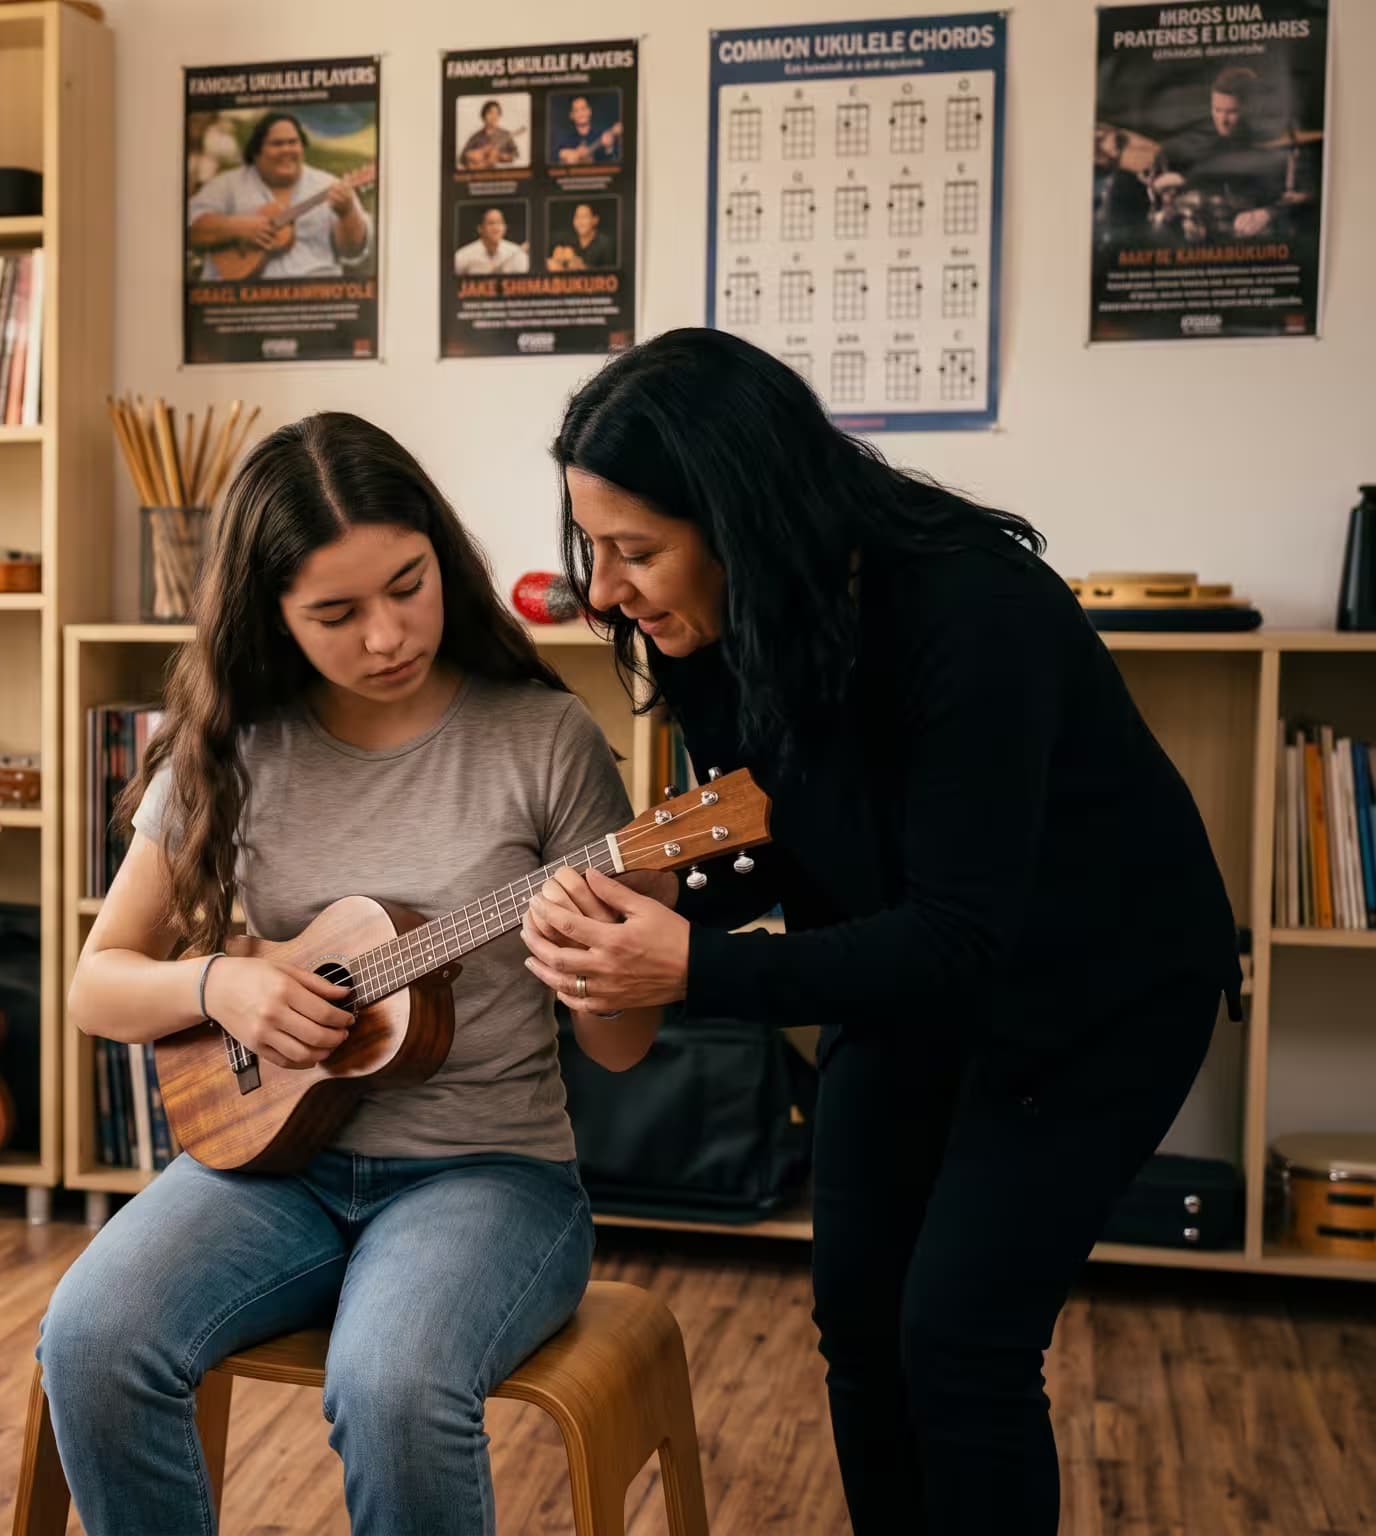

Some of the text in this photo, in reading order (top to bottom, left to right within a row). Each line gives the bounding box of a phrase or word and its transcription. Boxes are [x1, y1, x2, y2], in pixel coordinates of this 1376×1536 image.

[1226, 4, 1262, 22] UNA
[719, 25, 995, 63] COMMON UKULELE CHORDS
[447, 50, 634, 78] FAMOUS UKULELE PLAYERS
[189, 66, 376, 94] FAMOUS UKULELE PLAYERS
